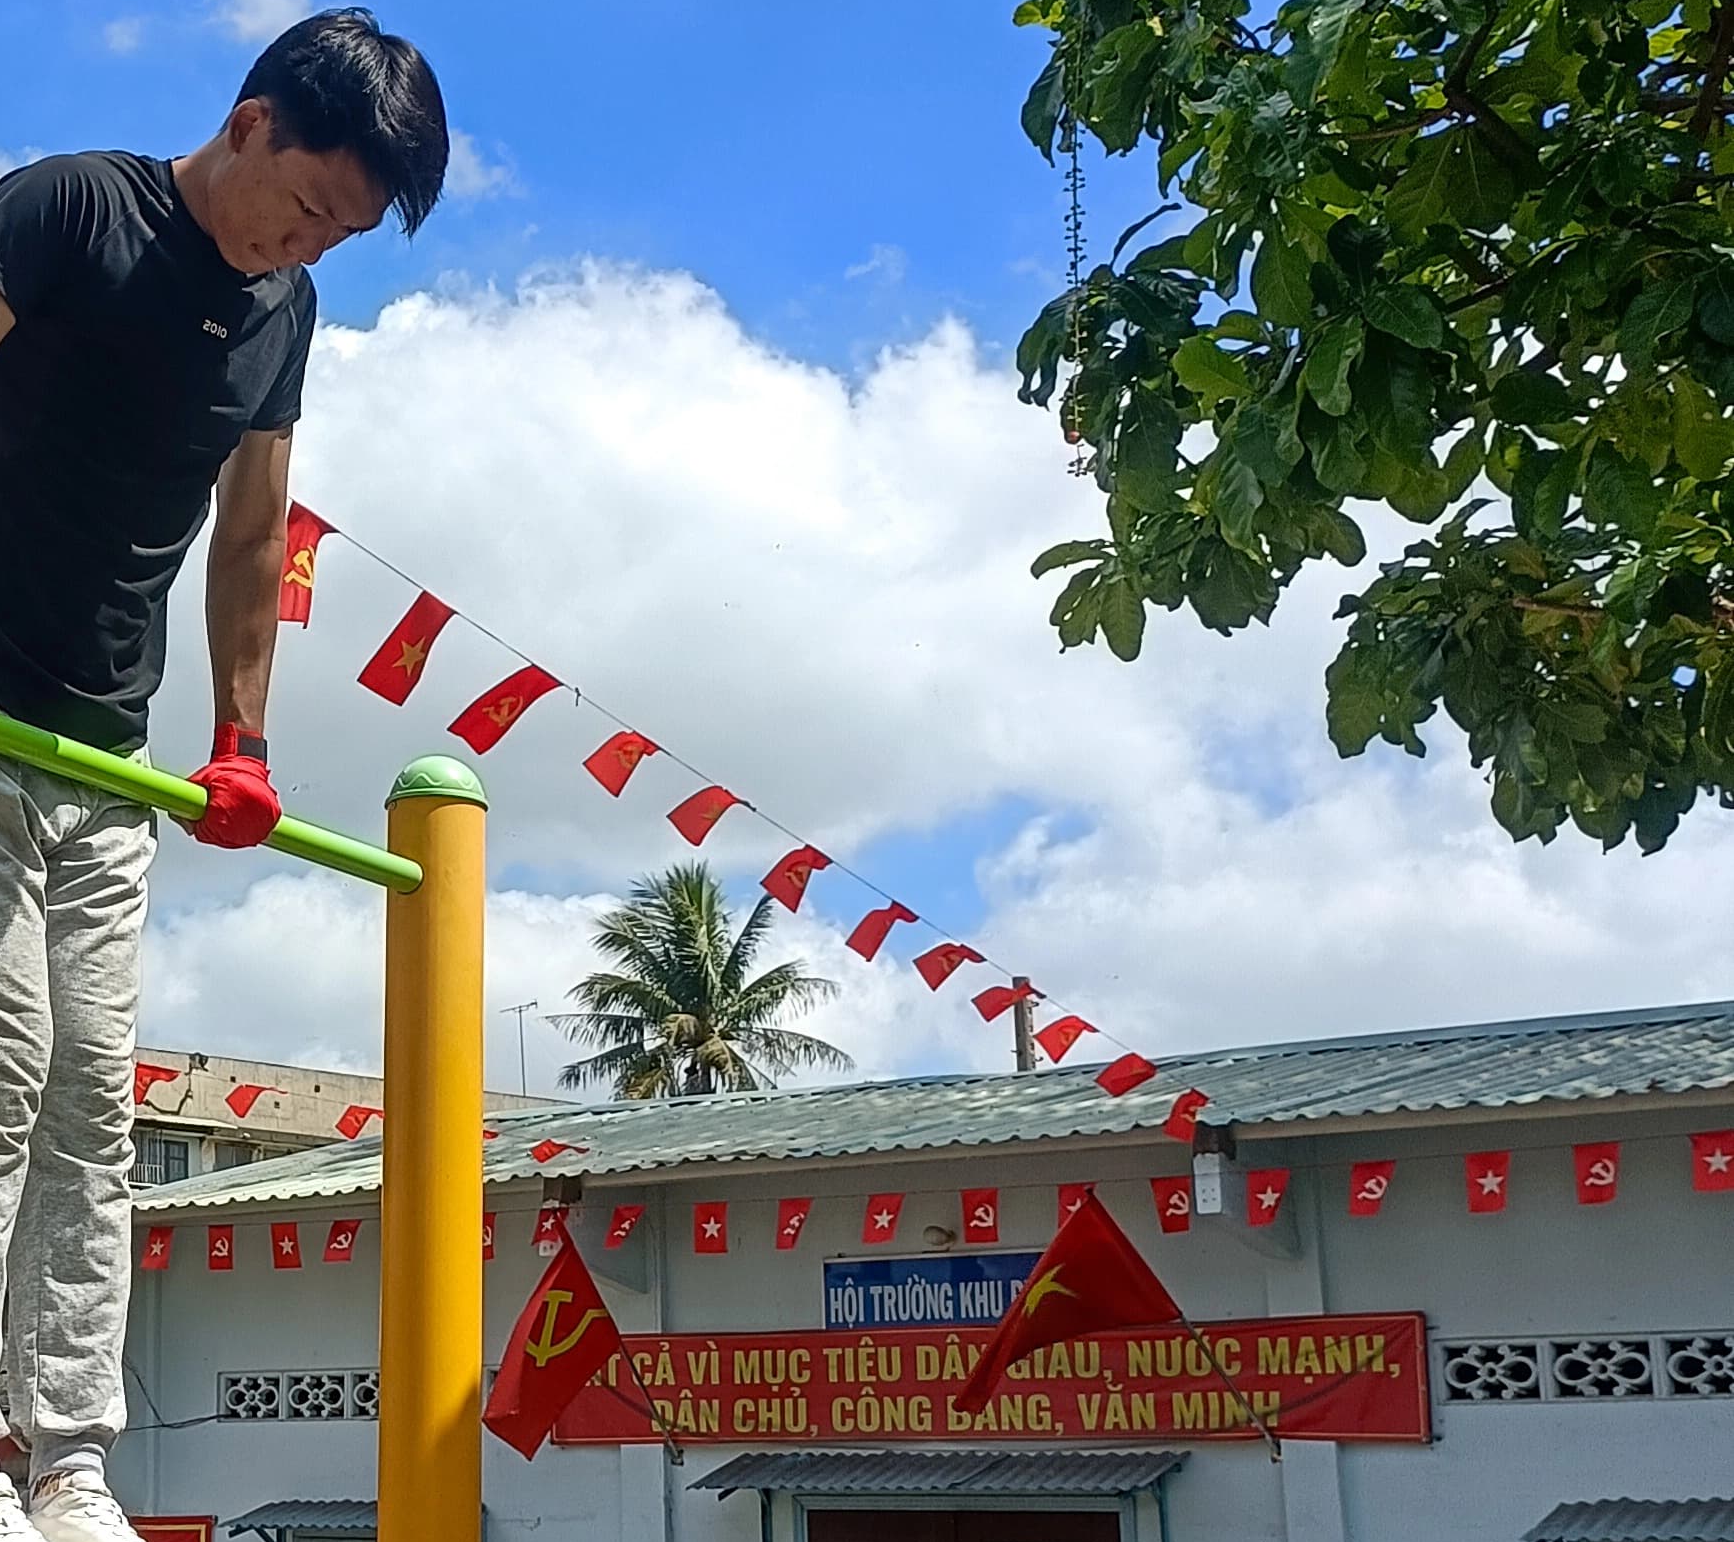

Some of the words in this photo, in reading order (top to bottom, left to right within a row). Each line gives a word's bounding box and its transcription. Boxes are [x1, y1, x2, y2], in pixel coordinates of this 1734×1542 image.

[202, 318, 228, 339] 2010
[829, 1277, 864, 1329] HỘI
[870, 1274, 954, 1322] TRƯỜNG
[959, 1280, 1003, 1319] KHU
[632, 1341, 676, 1387] CẢ
[686, 1340, 720, 1385] VÌ
[733, 1348, 812, 1393] MỤC
[823, 1334, 902, 1384] TIÊU
[1127, 1329, 1241, 1378] NƯỚC
[1258, 1333, 1401, 1385] MẠNH,
[651, 1389, 720, 1434] DÂN
[733, 1387, 818, 1438] CHỦ,
[831, 1386, 933, 1433] CÔNG
[1076, 1384, 1156, 1431] VĂN
[1172, 1391, 1280, 1431] MINH
